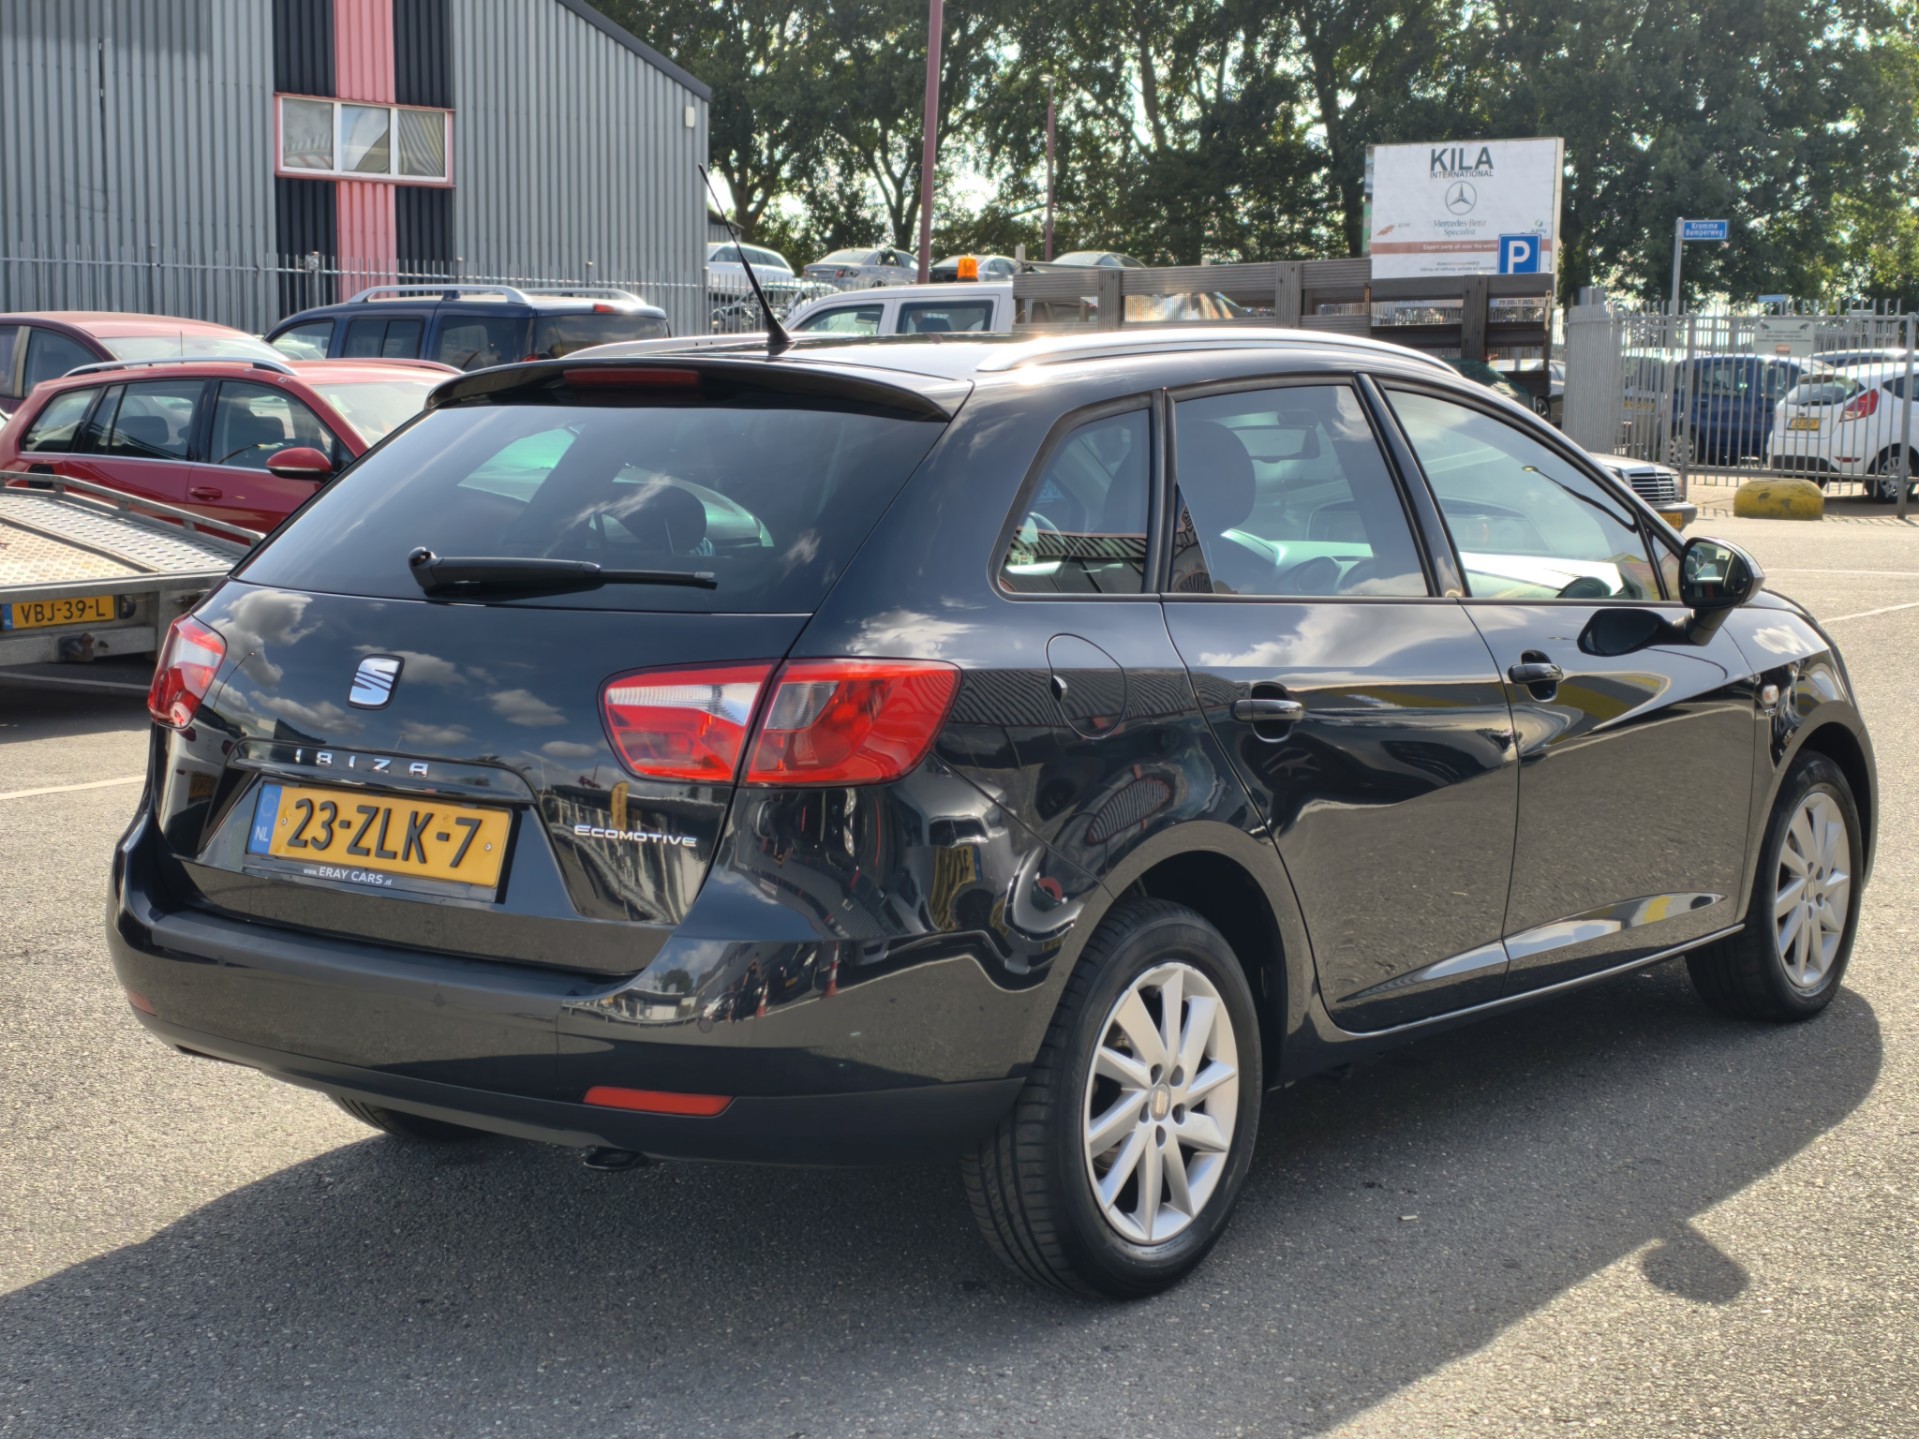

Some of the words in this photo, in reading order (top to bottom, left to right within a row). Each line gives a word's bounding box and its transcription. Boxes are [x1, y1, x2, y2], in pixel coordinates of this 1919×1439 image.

[1430, 146, 1494, 171] KILA
[1430, 169, 1494, 179] INTERNATIONAL
[1433, 218, 1487, 229] Mercedes-Benz
[1508, 240, 1530, 274] P
[21, 599, 106, 625] VBJ-39-L
[295, 749, 429, 778] IBIZA
[255, 826, 269, 842] NL
[287, 797, 483, 868] 23-ZLK-7
[574, 824, 697, 847] ECOMOTIVE
